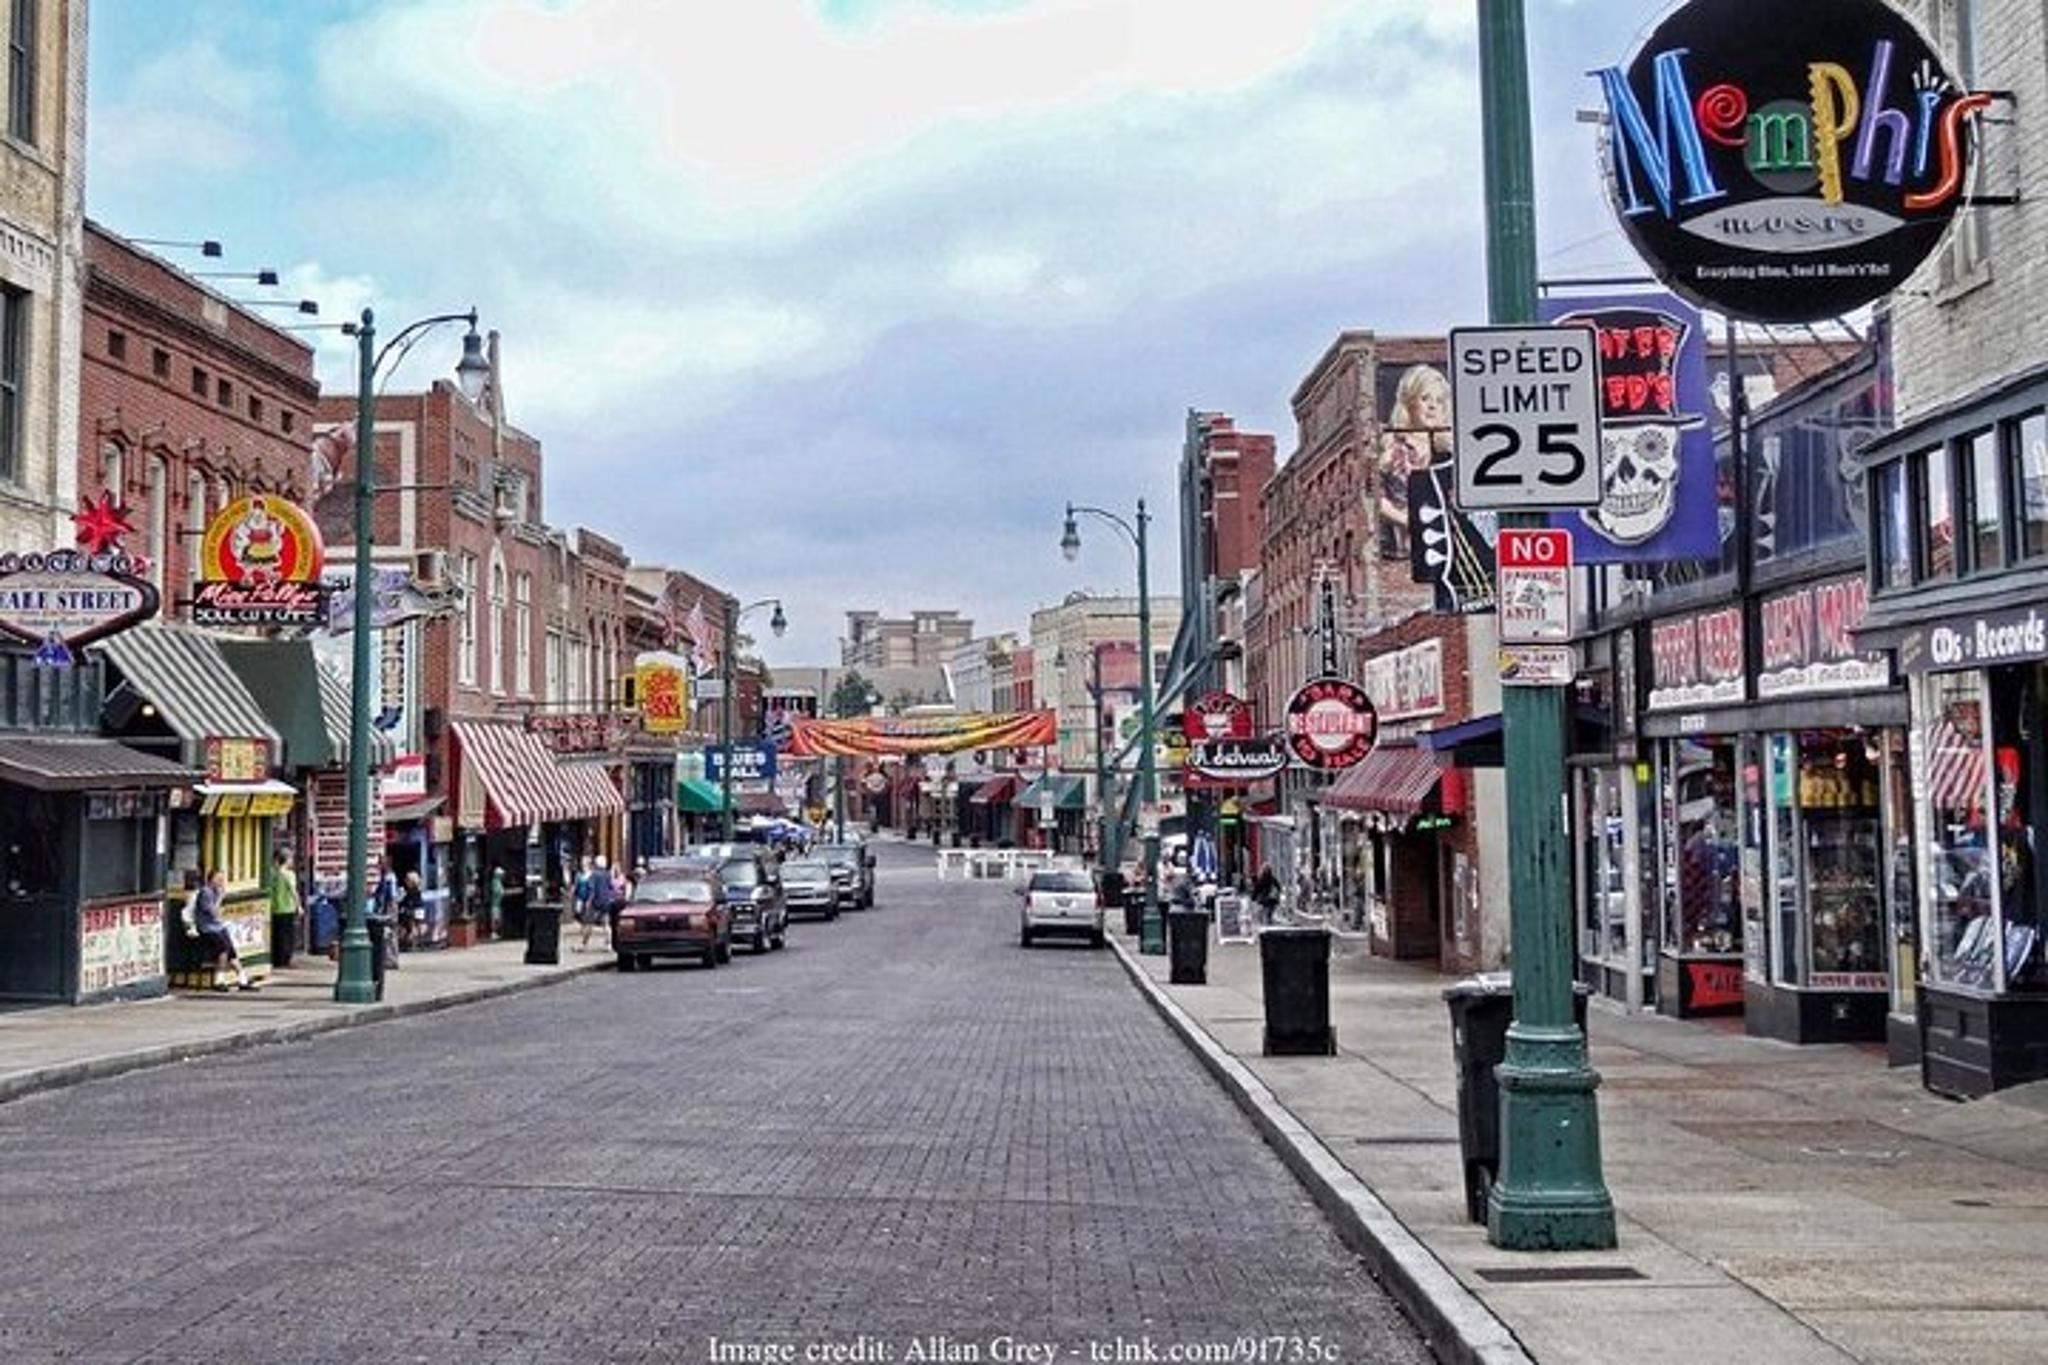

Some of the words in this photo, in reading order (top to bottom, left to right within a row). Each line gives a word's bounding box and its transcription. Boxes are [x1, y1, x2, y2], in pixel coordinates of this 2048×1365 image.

[1586, 38, 1993, 219] Memphis
[1464, 346, 1583, 376] SPEED
[1480, 383, 1571, 414] LIMIT
[1606, 371, 1671, 411] ED'S
[1470, 423, 1586, 486] 25
[1511, 536, 1554, 561] NO
[0, 591, 47, 609] EALE
[57, 591, 133, 609] STREET
[1976, 608, 2046, 659] Records
[712, 752, 766, 765] BUES
